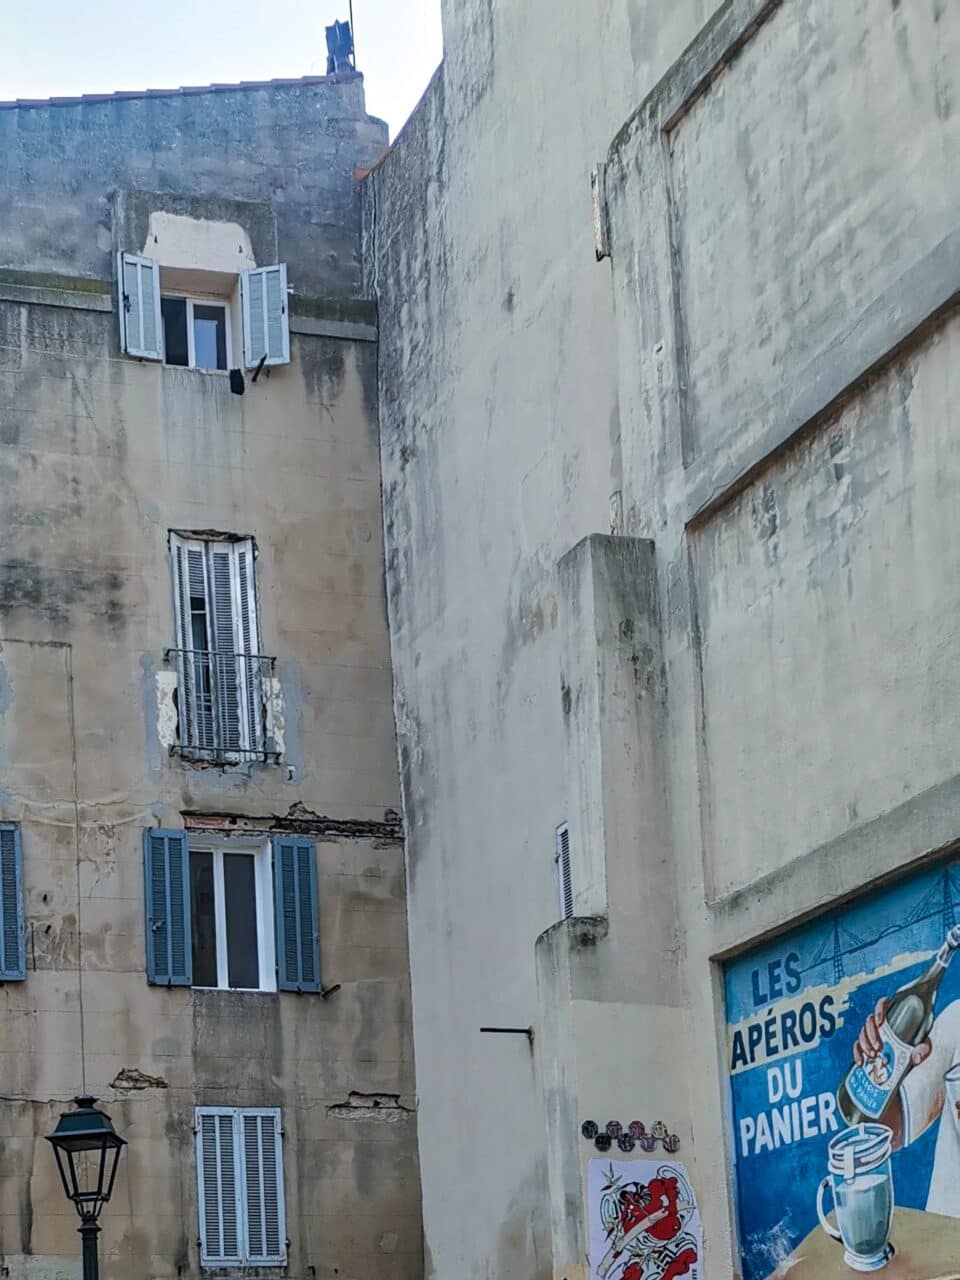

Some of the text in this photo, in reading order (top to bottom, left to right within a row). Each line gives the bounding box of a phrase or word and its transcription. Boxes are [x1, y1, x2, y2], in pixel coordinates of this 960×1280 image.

[751, 952, 802, 1006] LES
[731, 994, 837, 1070] APÉROS
[767, 1058, 803, 1104] DU
[740, 1091, 839, 1157] PANIER
